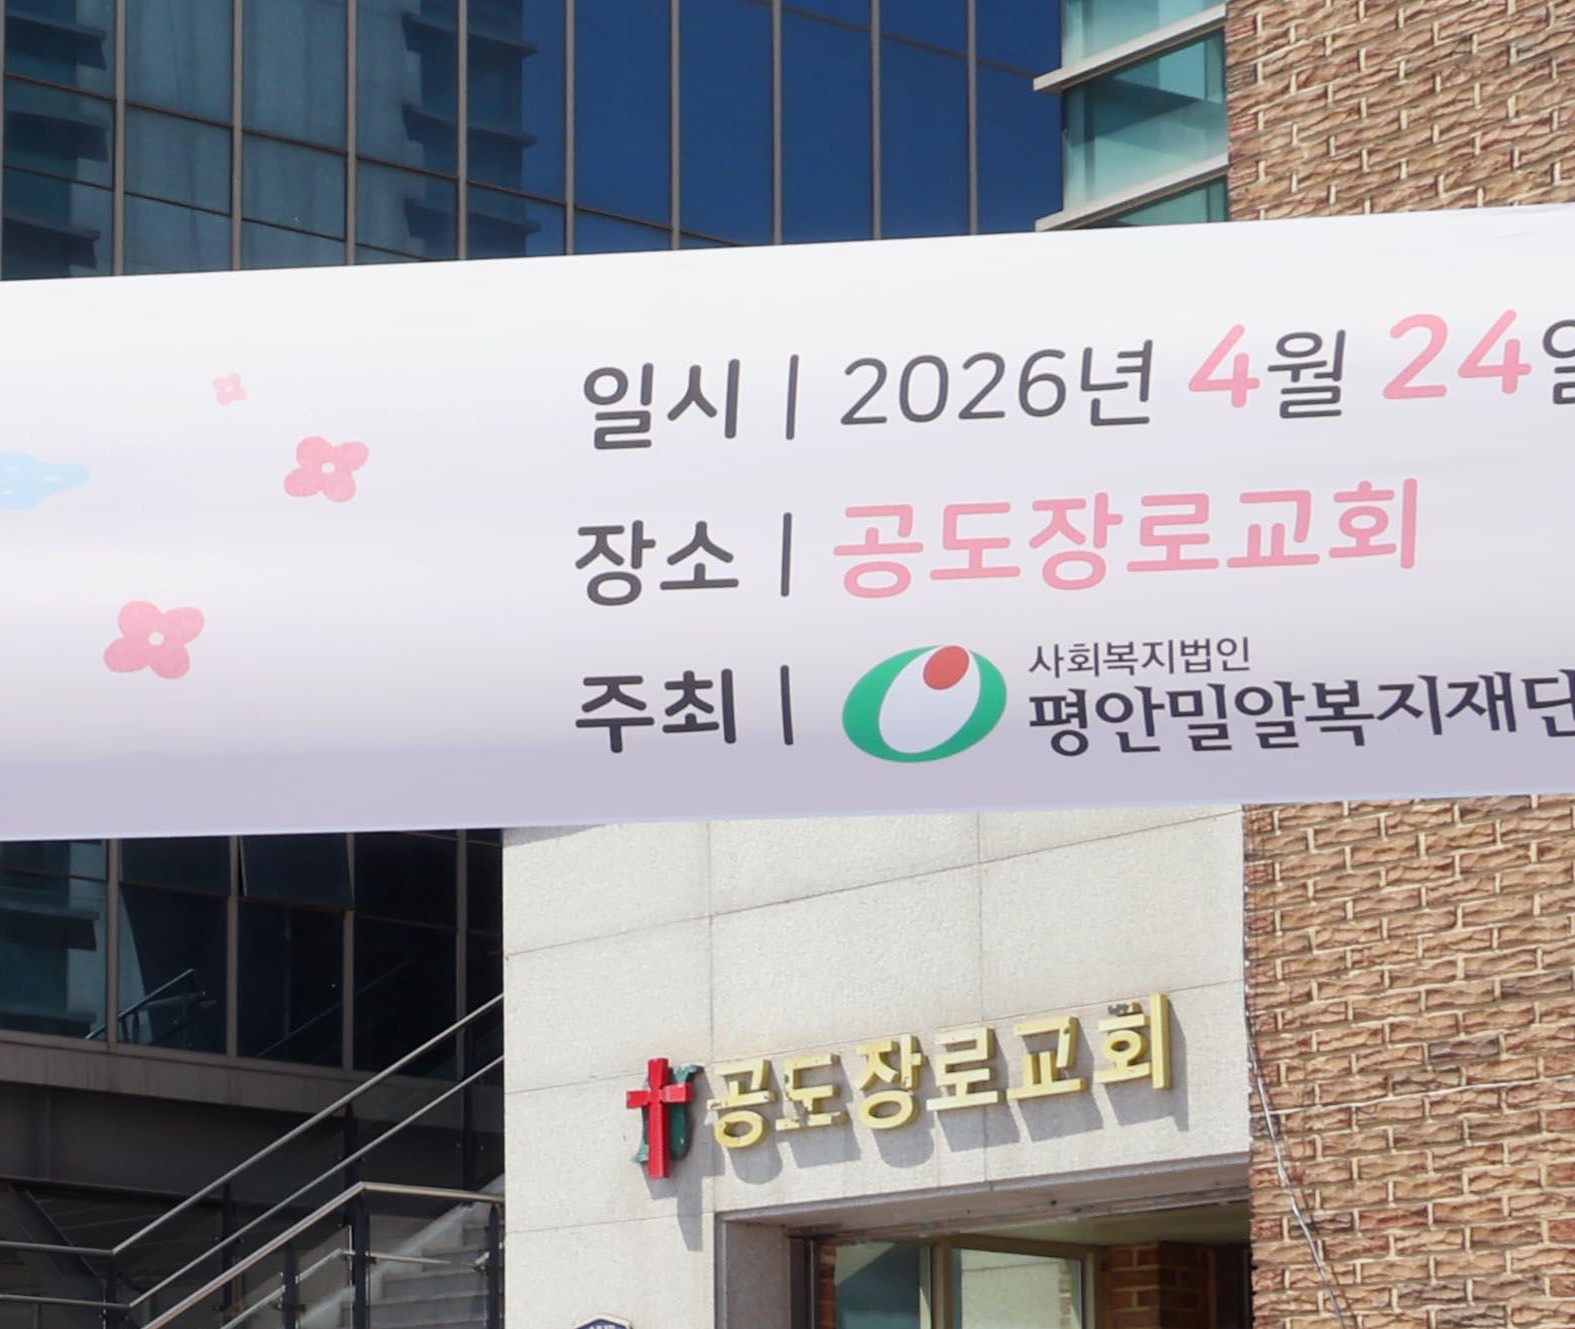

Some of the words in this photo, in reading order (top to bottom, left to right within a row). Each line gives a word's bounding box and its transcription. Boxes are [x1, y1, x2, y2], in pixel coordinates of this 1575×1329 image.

[584, 359, 740, 450] 일시
[841, 339, 1154, 428] 2026년
[1189, 323, 1346, 419] 4월
[575, 519, 740, 606] 장소
[833, 478, 1419, 599] 공도장로교회
[575, 668, 737, 755] 주최
[1028, 668, 1575, 757] 평안밀알복지재단
[1030, 636, 1251, 680] 사회복지법인
[713, 993, 1173, 1149] 공도장로교회
